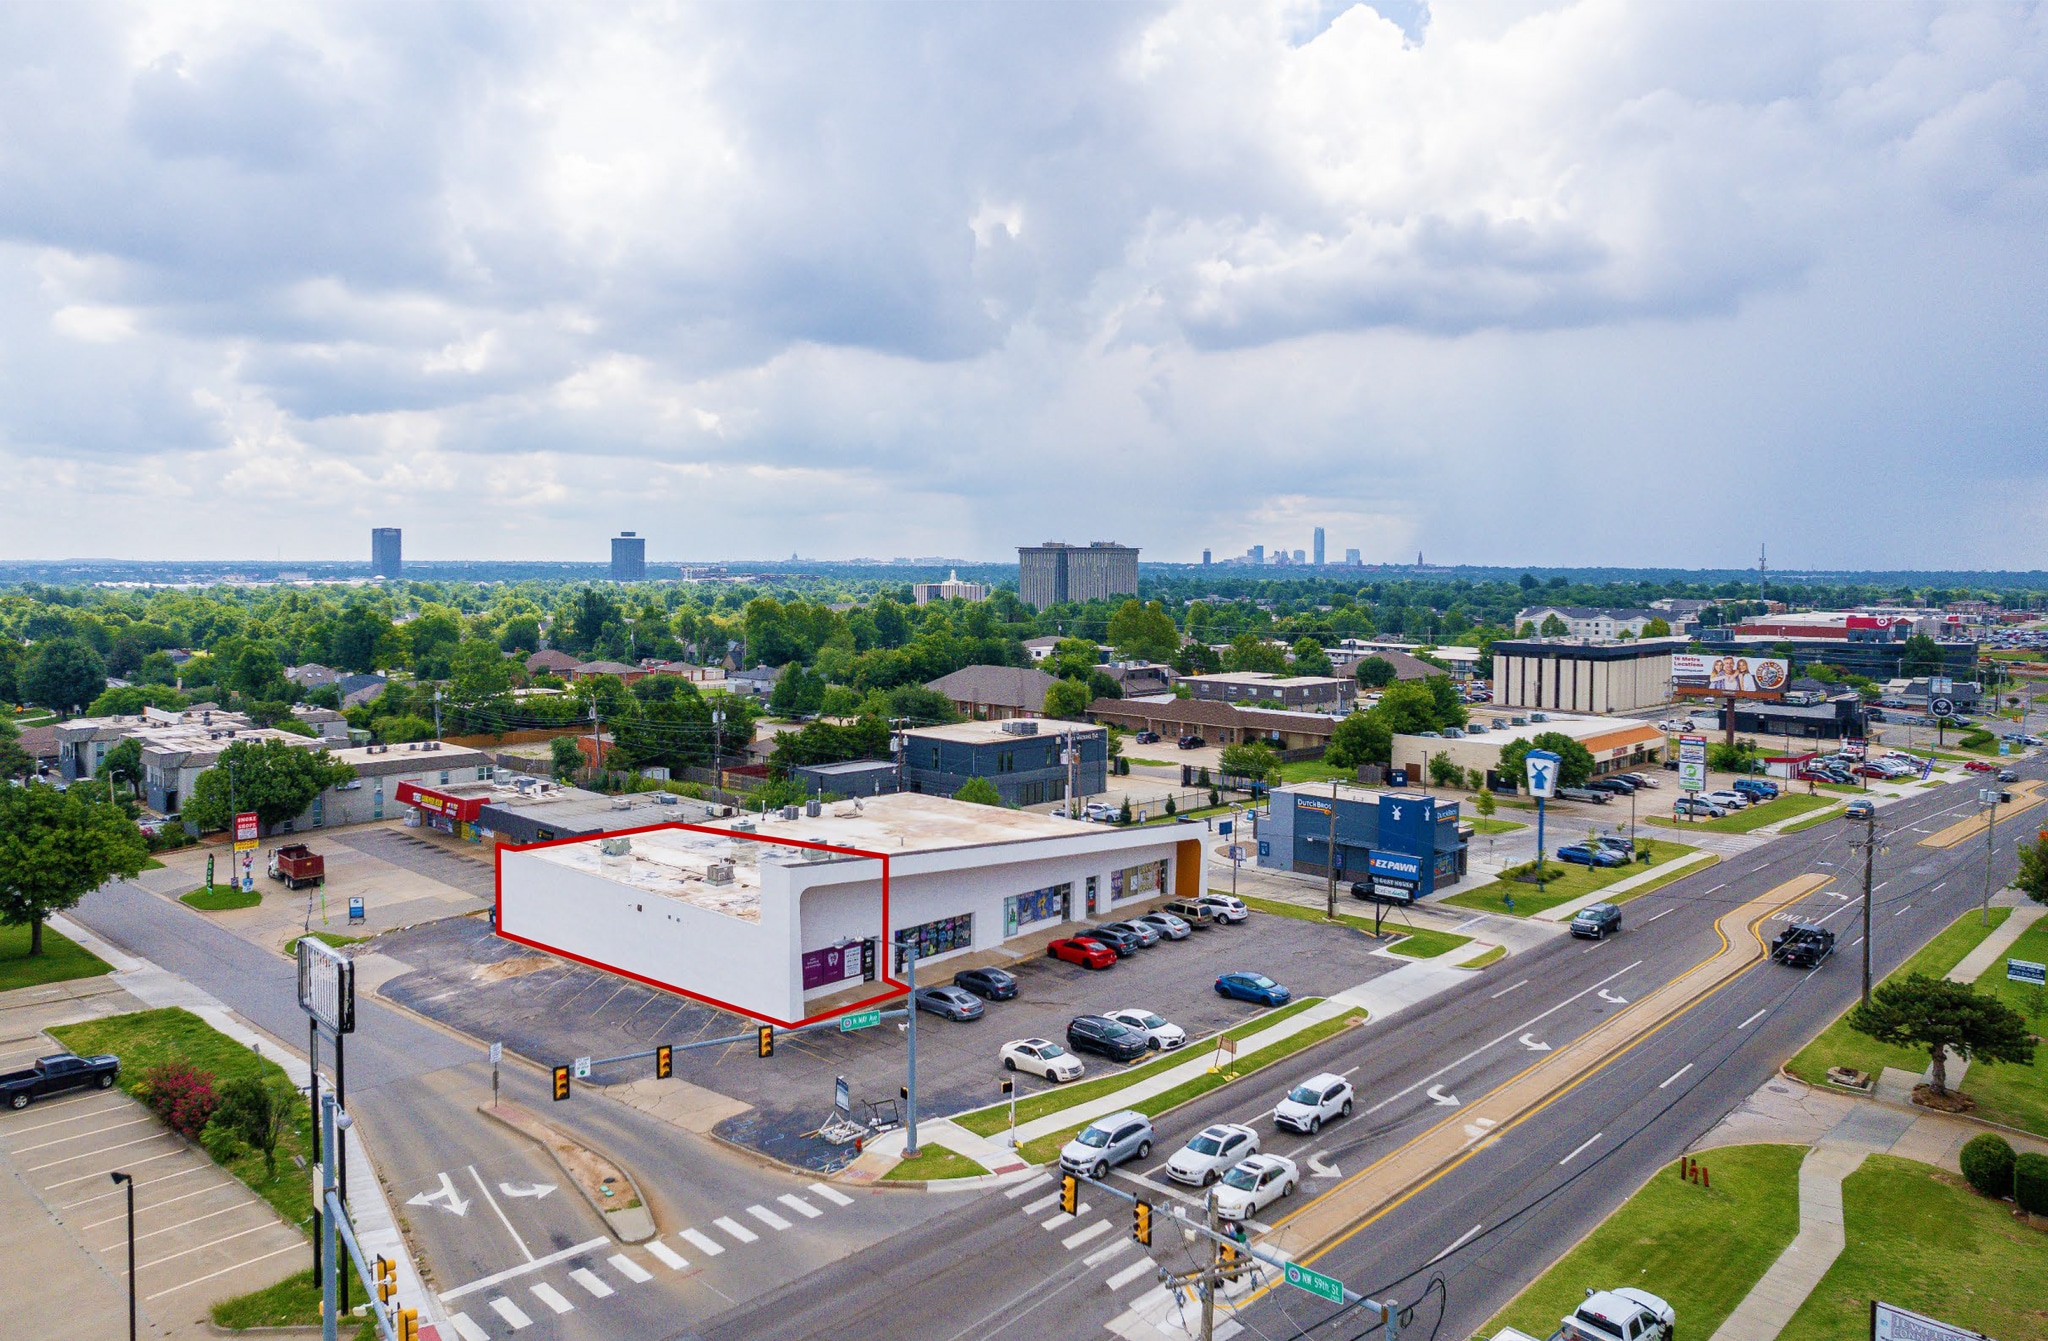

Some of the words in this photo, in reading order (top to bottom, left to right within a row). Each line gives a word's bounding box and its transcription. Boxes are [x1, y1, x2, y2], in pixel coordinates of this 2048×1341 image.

[1771, 912, 1819, 925] ONLY
[1302, 1272, 1312, 1286] NW
[1314, 1276, 1330, 1293] 59th
